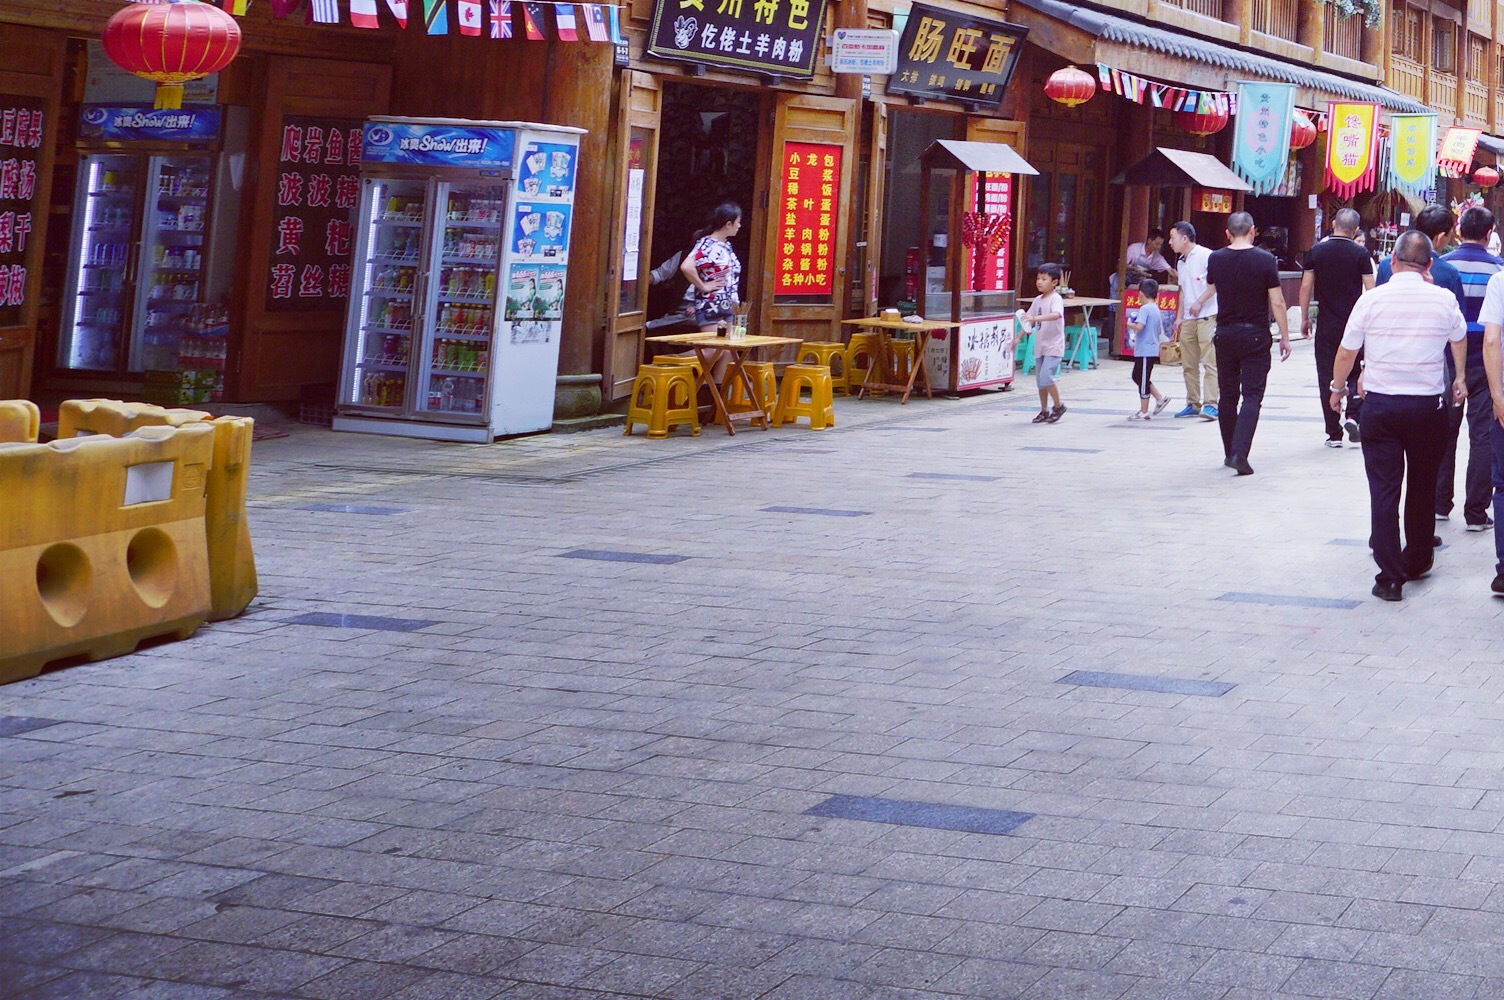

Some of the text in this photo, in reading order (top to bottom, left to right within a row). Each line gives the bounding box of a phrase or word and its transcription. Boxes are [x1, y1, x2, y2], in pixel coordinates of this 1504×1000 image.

[700, 22, 804, 63] 仡佬土羊肉粉
[908, 16, 1016, 75] 肠旺面
[1341, 115, 1361, 167] 馋嘴猫
[789, 152, 834, 167] 小龙包
[787, 167, 834, 181] 豆浆
[278, 171, 360, 208] 波波糖
[787, 182, 832, 196] 稀饭
[786, 198, 832, 211] 茶叶蛋
[784, 228, 830, 241] 羊肉粉
[783, 243, 829, 256] 砂锅粉
[781, 273, 827, 286] 各种小吃
